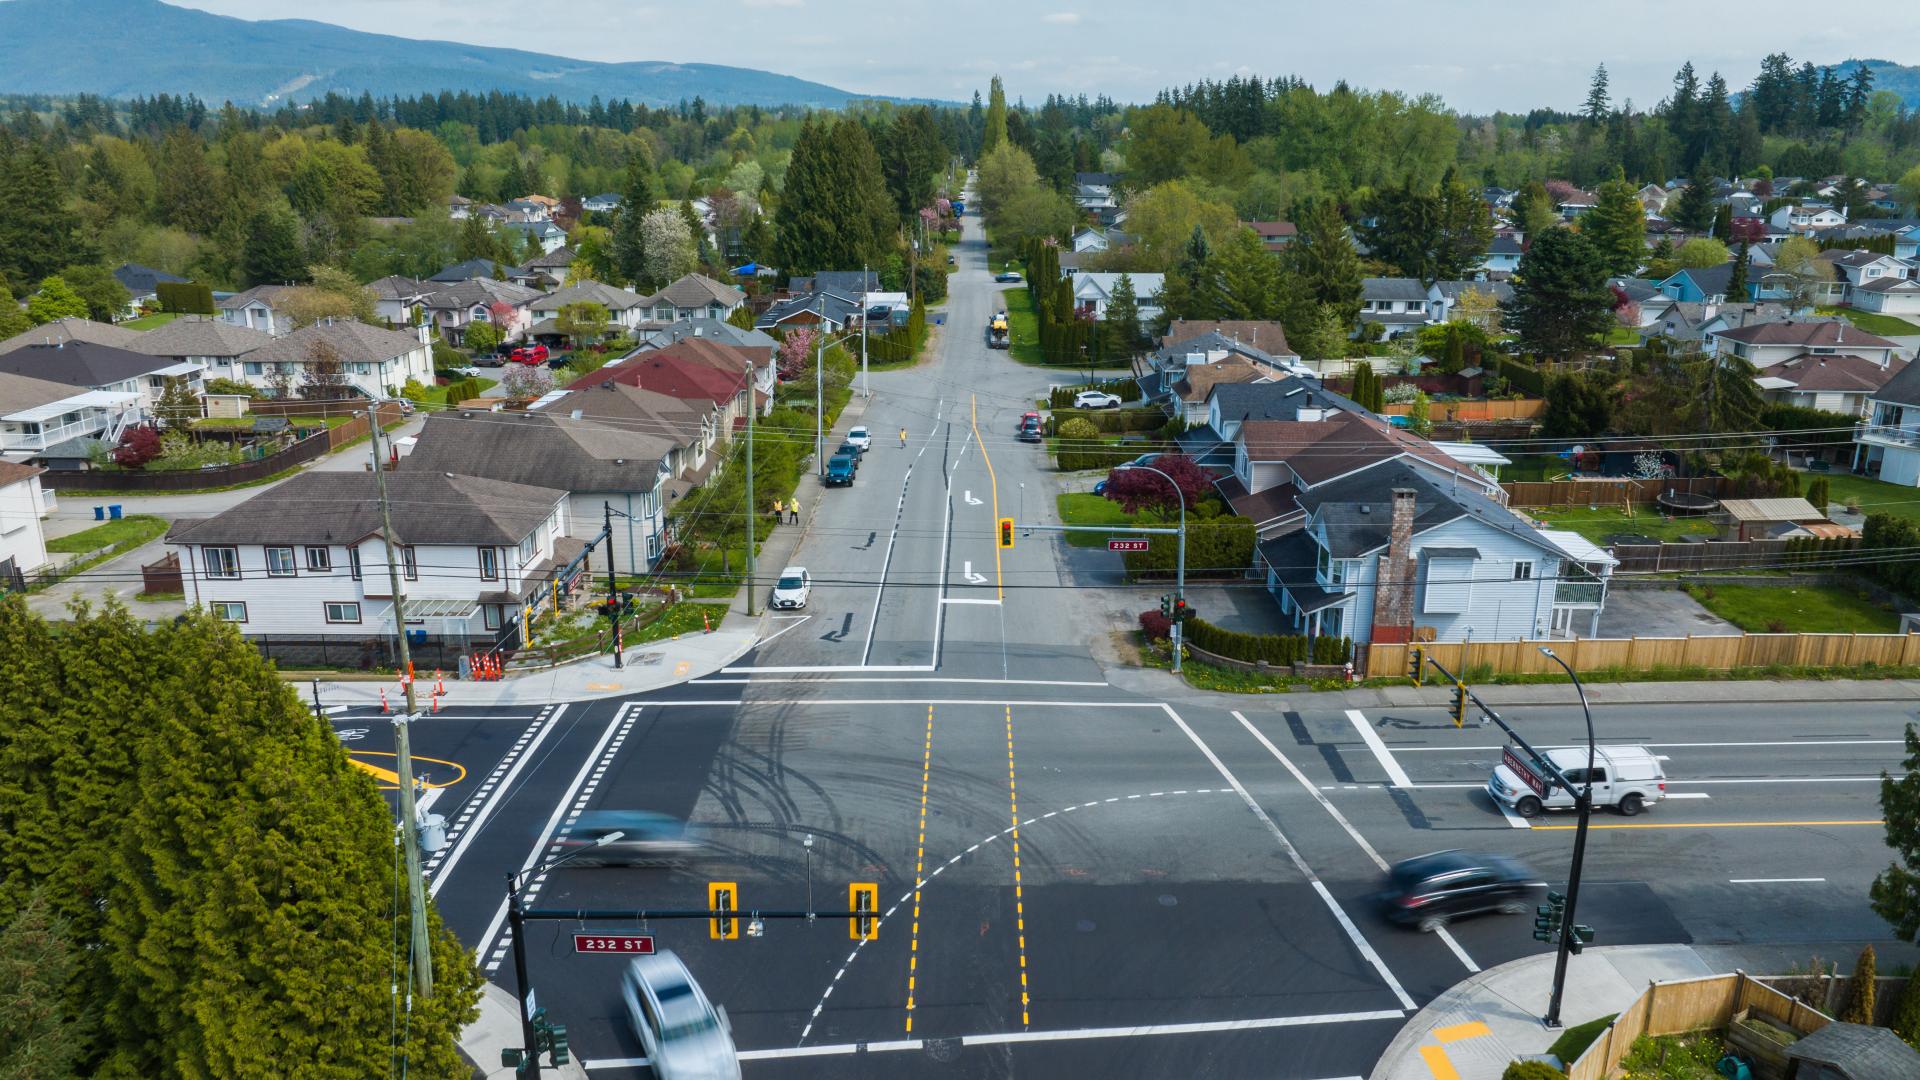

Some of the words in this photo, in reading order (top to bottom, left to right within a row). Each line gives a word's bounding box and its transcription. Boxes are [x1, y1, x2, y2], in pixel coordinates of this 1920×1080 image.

[1532, 777, 1542, 793] WAY
[586, 940, 616, 949] 232
[624, 940, 643, 950] ST
